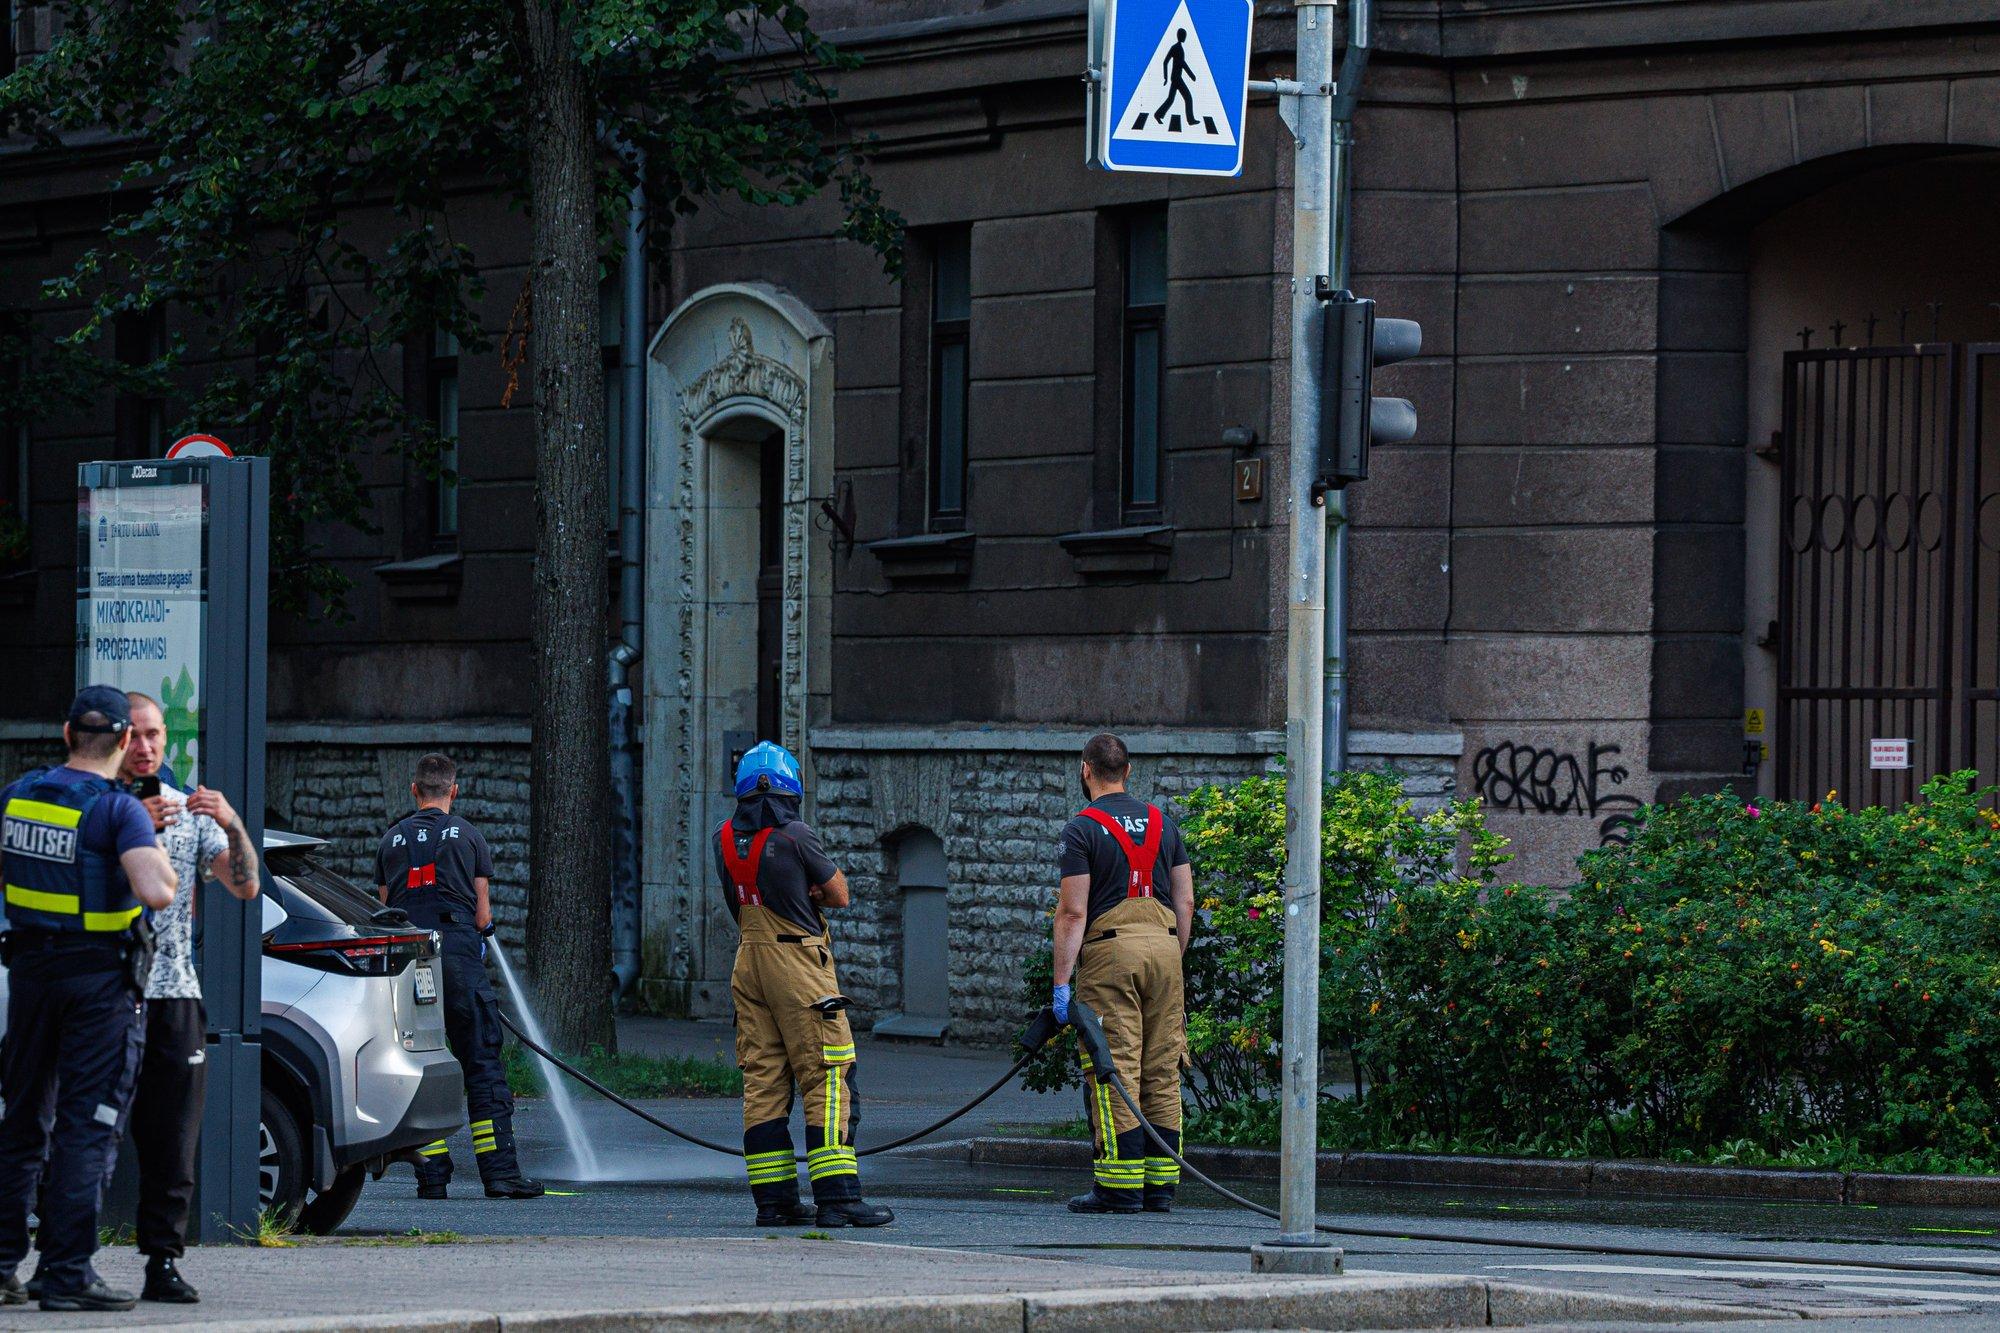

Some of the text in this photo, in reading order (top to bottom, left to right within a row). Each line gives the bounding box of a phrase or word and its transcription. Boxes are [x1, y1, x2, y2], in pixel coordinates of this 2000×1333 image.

[132, 466, 157, 478] JCDecaux
[1243, 466, 1250, 490] 2
[121, 576, 136, 586] oma
[137, 572, 167, 586] teadmiste
[167, 570, 192, 588] pagasit
[97, 600, 171, 625] MIKROKRAADI-
[97, 637, 167, 661] PROGRAMMIS!
[2, 820, 74, 858] POLITSEI
